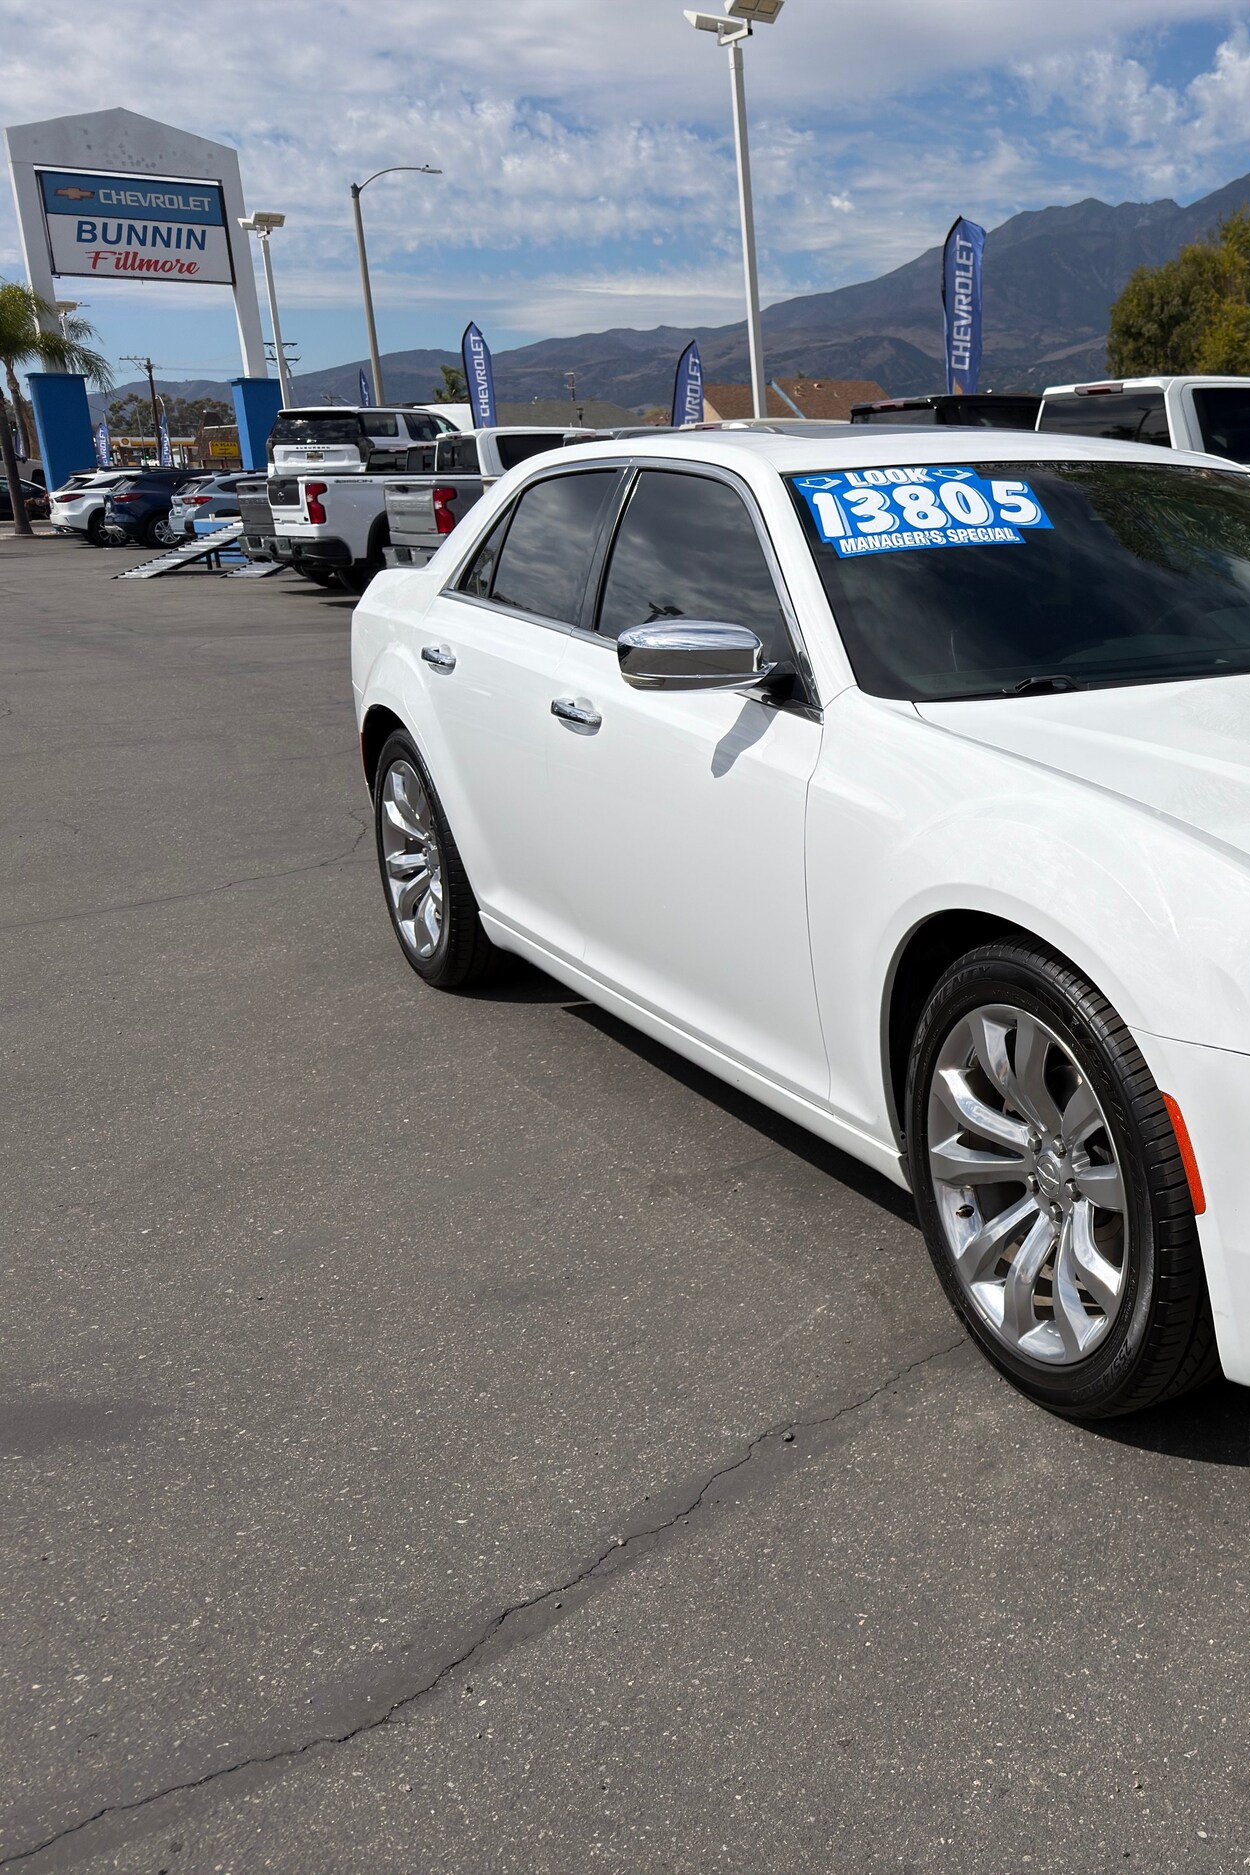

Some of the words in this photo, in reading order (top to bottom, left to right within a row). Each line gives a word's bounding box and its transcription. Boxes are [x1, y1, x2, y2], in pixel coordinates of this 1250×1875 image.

[99, 189, 211, 211] CHEVROLET
[76, 220, 207, 250] BUNNIN
[85, 250, 200, 275] Fillmore
[951, 235, 974, 371] CHEVROLET
[470, 333, 490, 417] CHEVROLET
[844, 467, 933, 487] LOOK
[812, 481, 1040, 538] 13805
[839, 529, 946, 554] MANAGER'S
[949, 527, 1020, 545] SPECIAL
